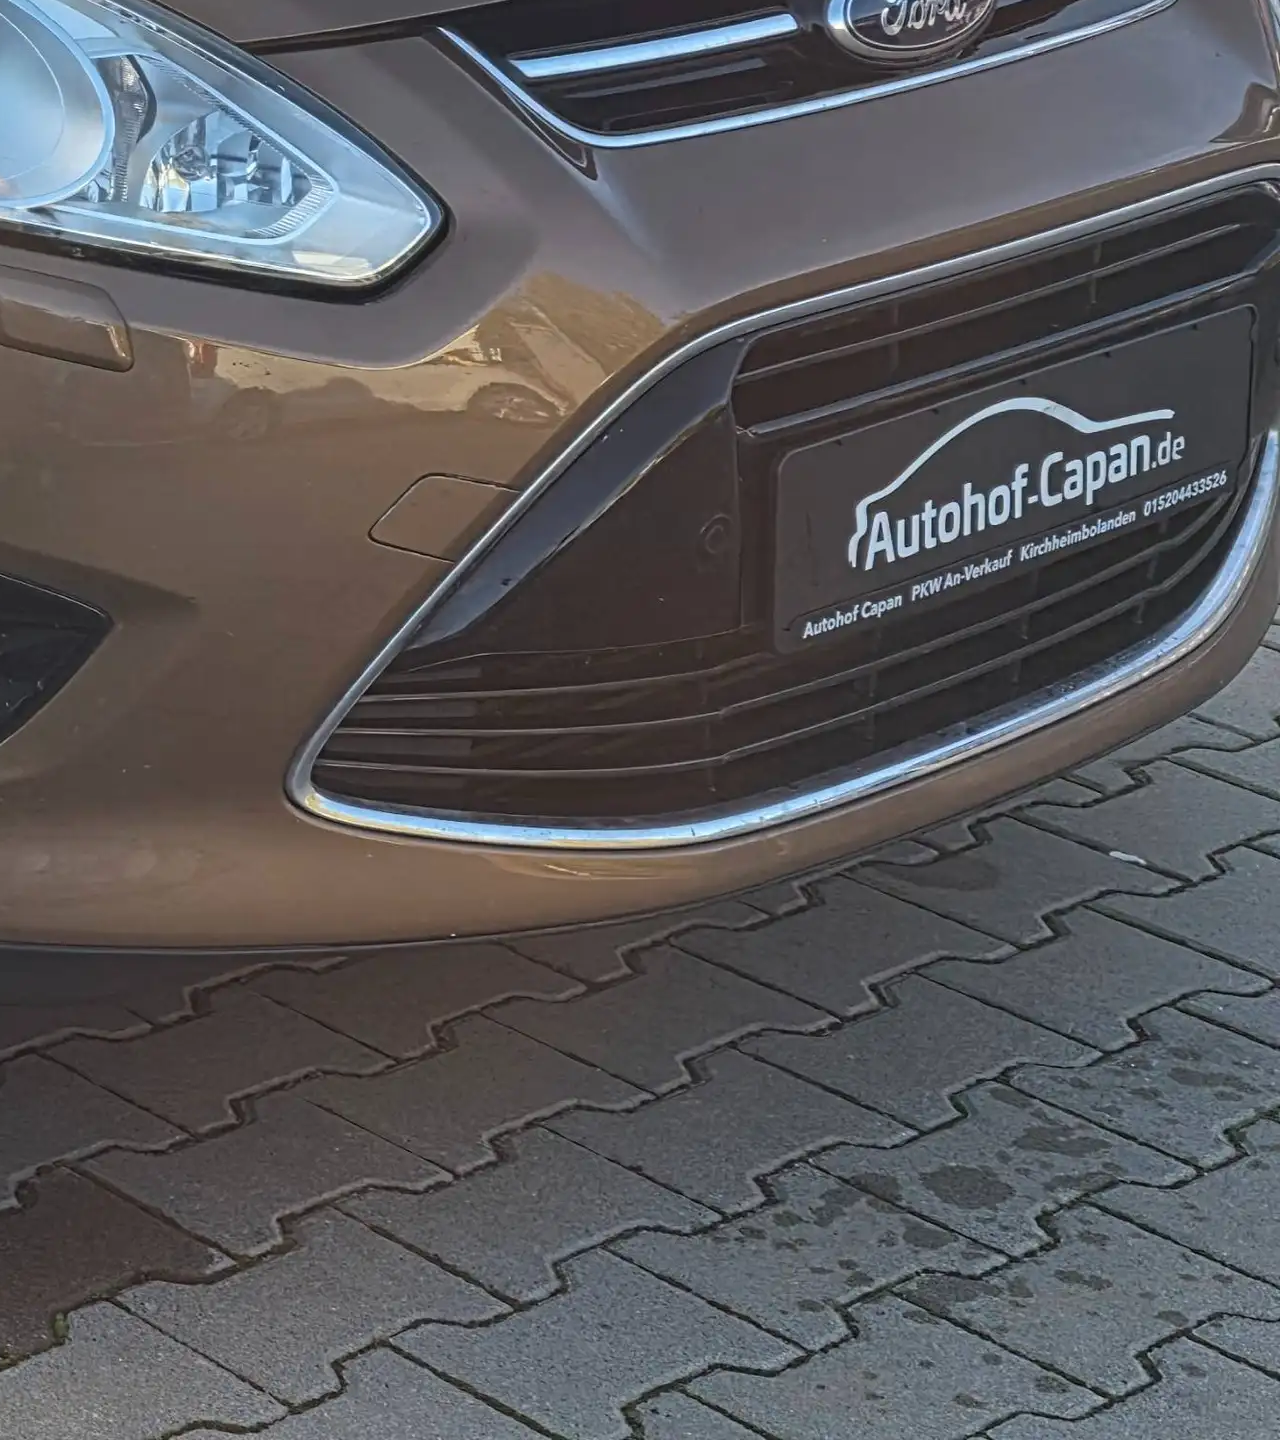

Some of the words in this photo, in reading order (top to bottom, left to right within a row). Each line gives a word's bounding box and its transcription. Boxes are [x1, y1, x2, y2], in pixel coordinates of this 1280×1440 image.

[802, 603, 859, 639] Autohof
[861, 594, 903, 619] Capan
[911, 575, 943, 602] PKW
[943, 549, 1013, 590] An-Verkauf
[1020, 510, 1136, 561] Kirchheimbolanden
[1143, 469, 1228, 517] 015204433526
[864, 431, 1185, 571] Autohof-Capan.de
